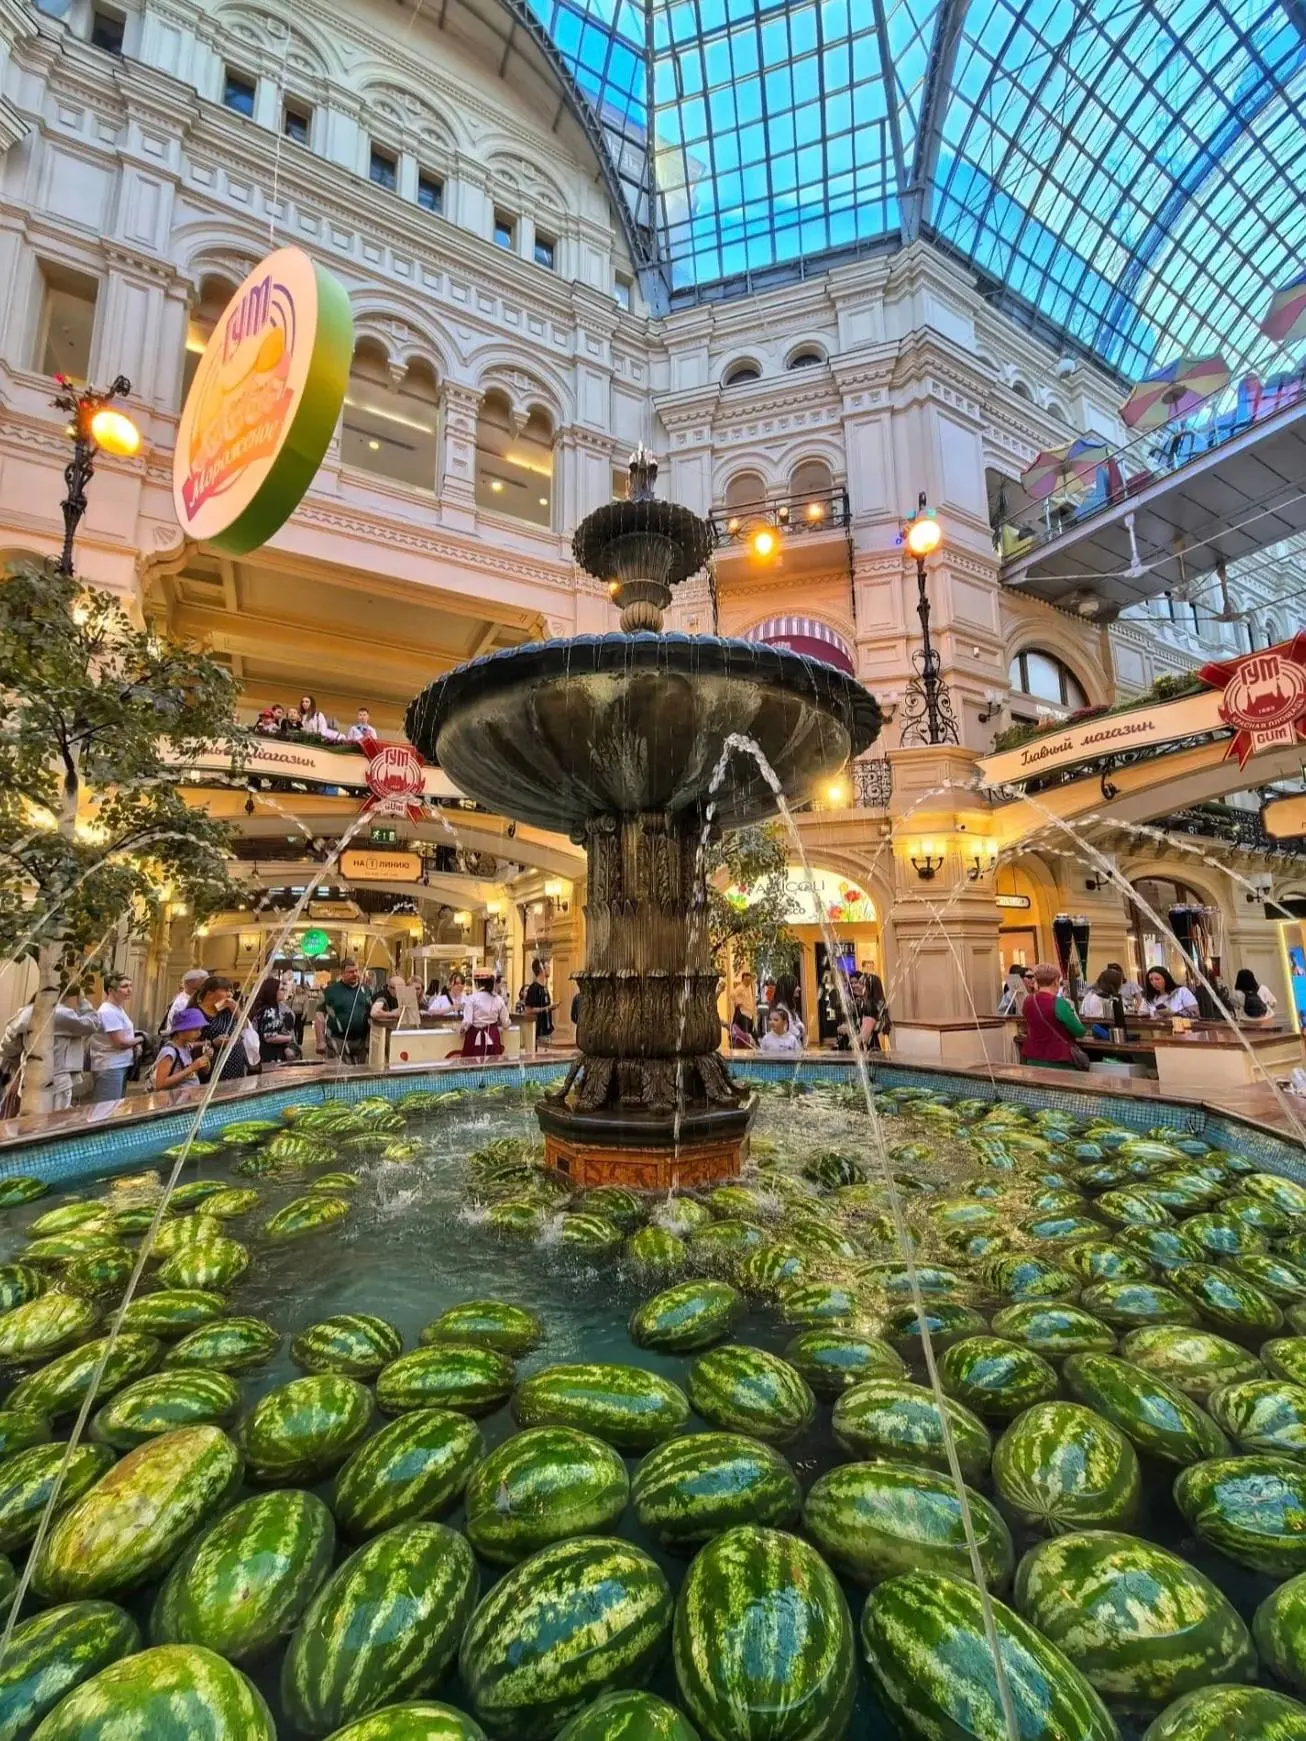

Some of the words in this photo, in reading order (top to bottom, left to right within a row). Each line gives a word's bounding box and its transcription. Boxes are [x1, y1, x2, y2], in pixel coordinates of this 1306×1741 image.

[223, 275, 272, 364] ГУМ
[1240, 656, 1280, 685] ГУМ
[385, 749, 409, 766] ГУМ
[1020, 737, 1074, 766] Главный
[1080, 721, 1156, 746] магазин
[353, 859, 365, 867] НА
[379, 861, 410, 869] ЛИНИЮ
